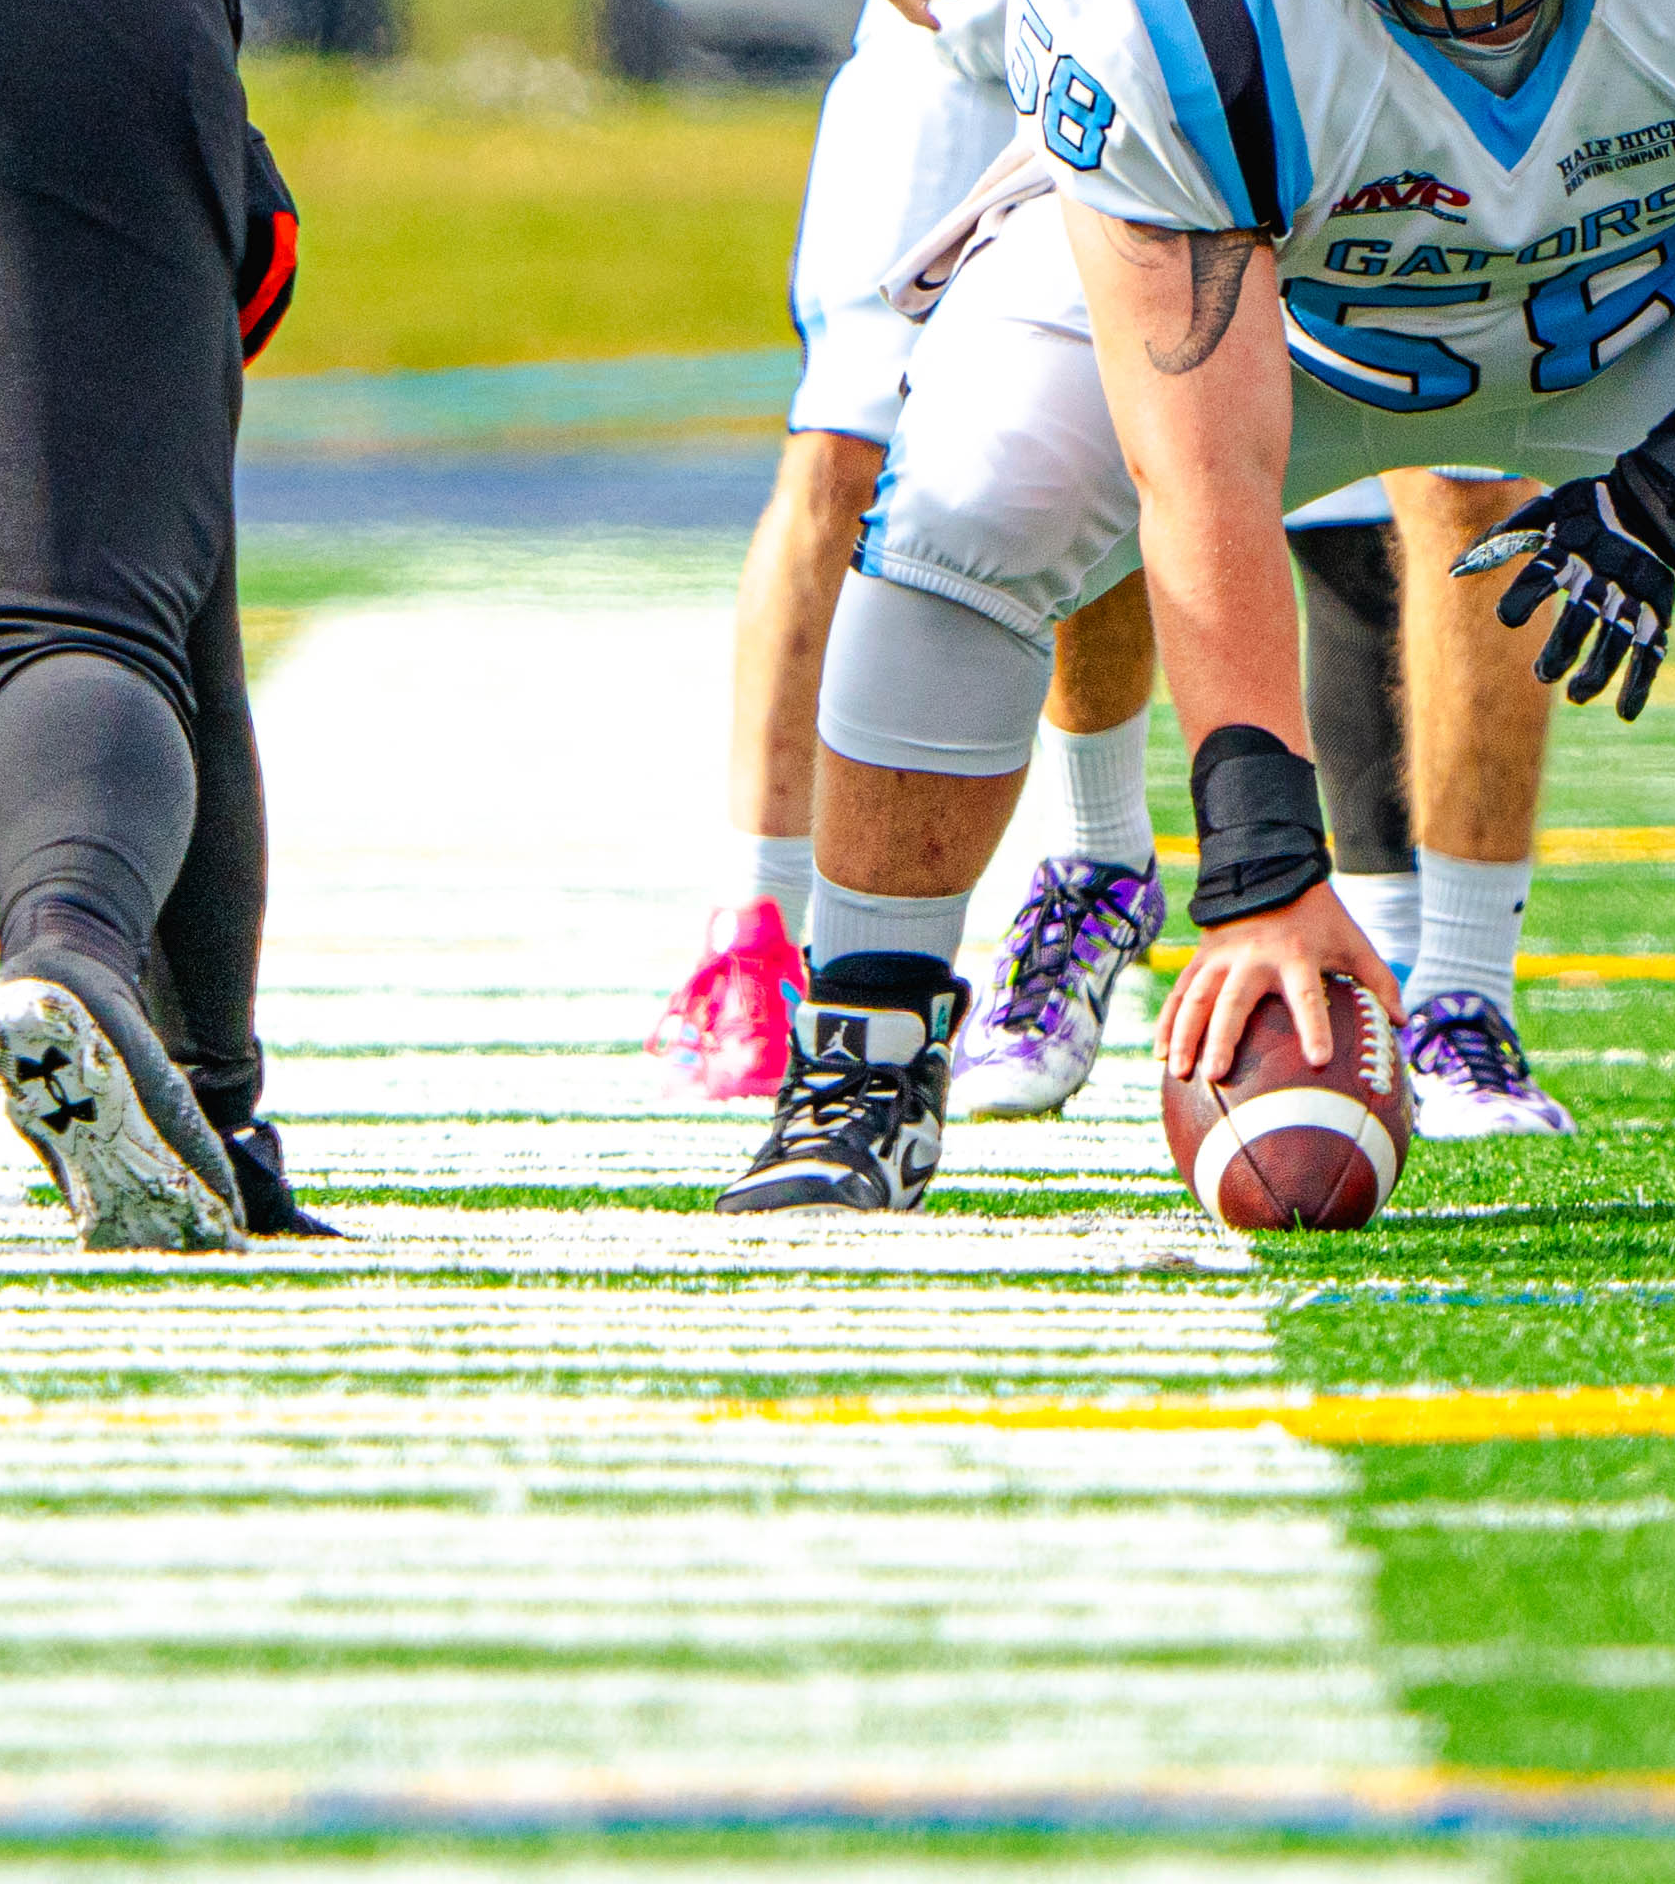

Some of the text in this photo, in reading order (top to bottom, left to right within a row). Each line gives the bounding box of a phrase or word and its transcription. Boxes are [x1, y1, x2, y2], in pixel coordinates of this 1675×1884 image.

[1556, 138, 1613, 178] HALF
[1564, 143, 1671, 197] BREWING COMPANY
[1329, 179, 1471, 212] MVP
